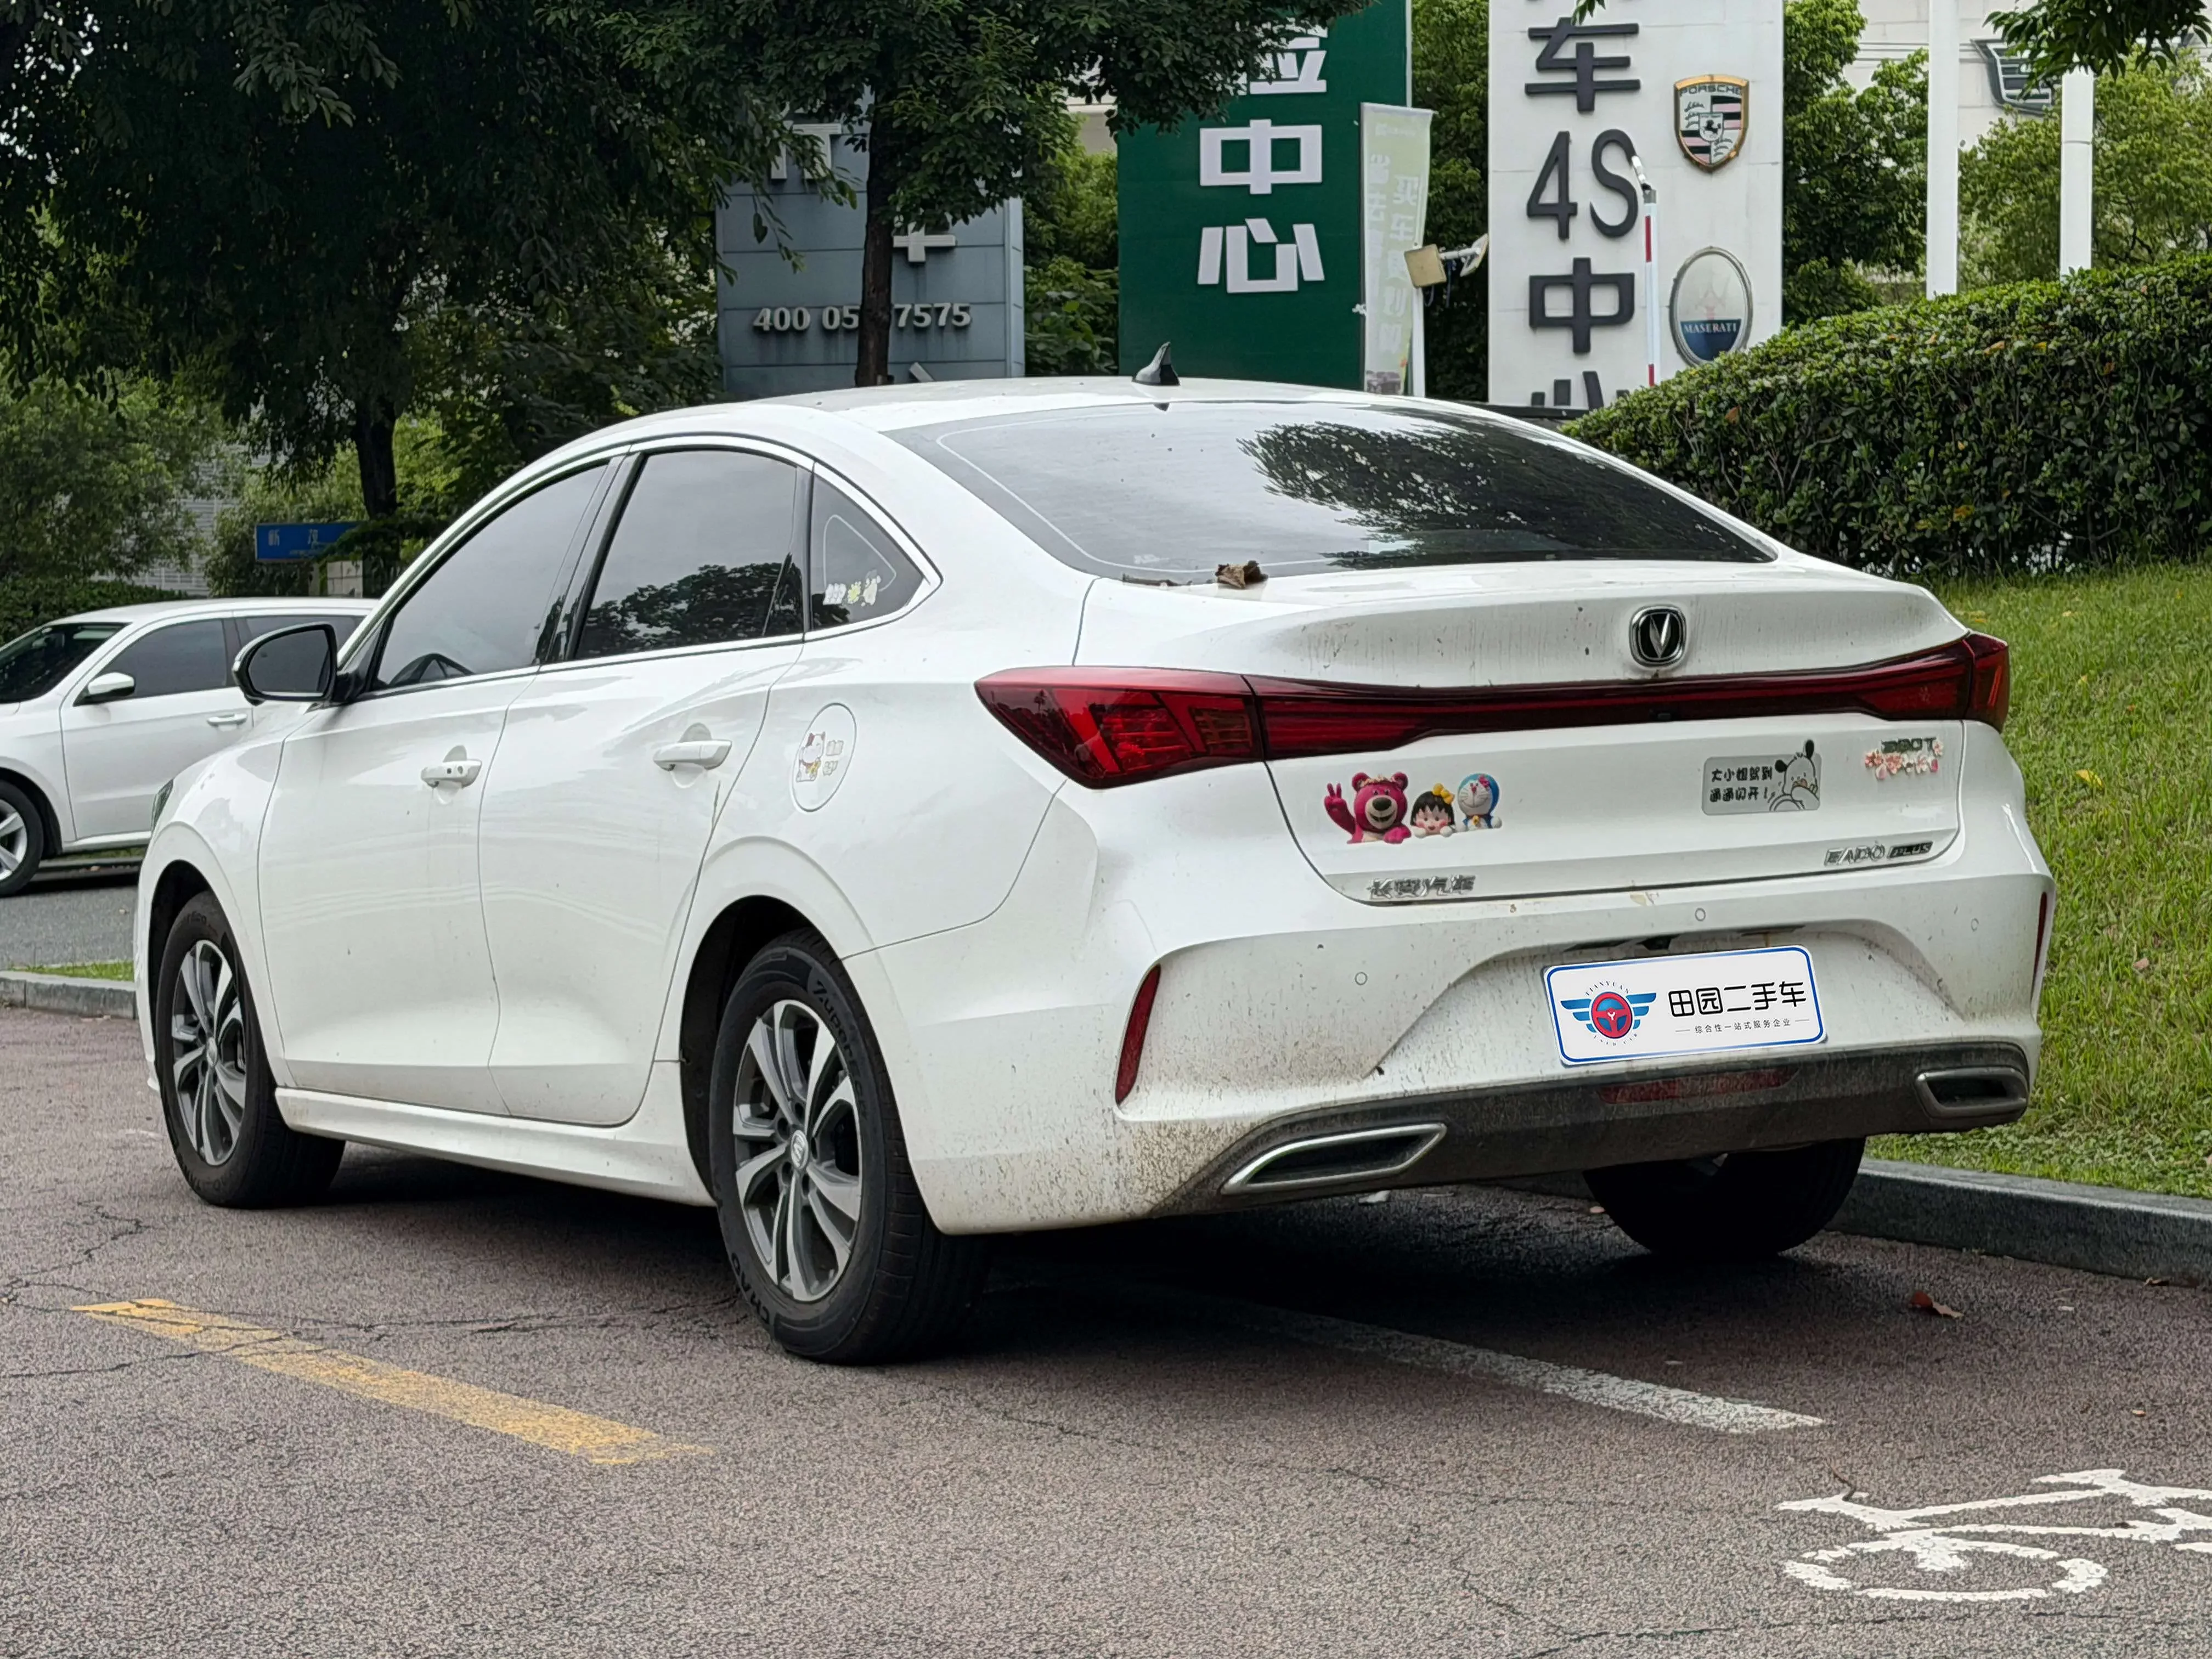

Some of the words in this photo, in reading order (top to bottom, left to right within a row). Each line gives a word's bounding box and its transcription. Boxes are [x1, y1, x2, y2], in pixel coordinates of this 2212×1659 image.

[1679, 84, 1742, 97] PORSCHE
[753, 306, 811, 331] 400
[822, 305, 862, 330] 05
[894, 302, 972, 328] 7575
[1684, 323, 1736, 334] MASERATI
[1711, 765, 1773, 782] 大小姐驾到
[1824, 842, 1885, 867] EADO
[1889, 842, 1932, 858] PLUS
